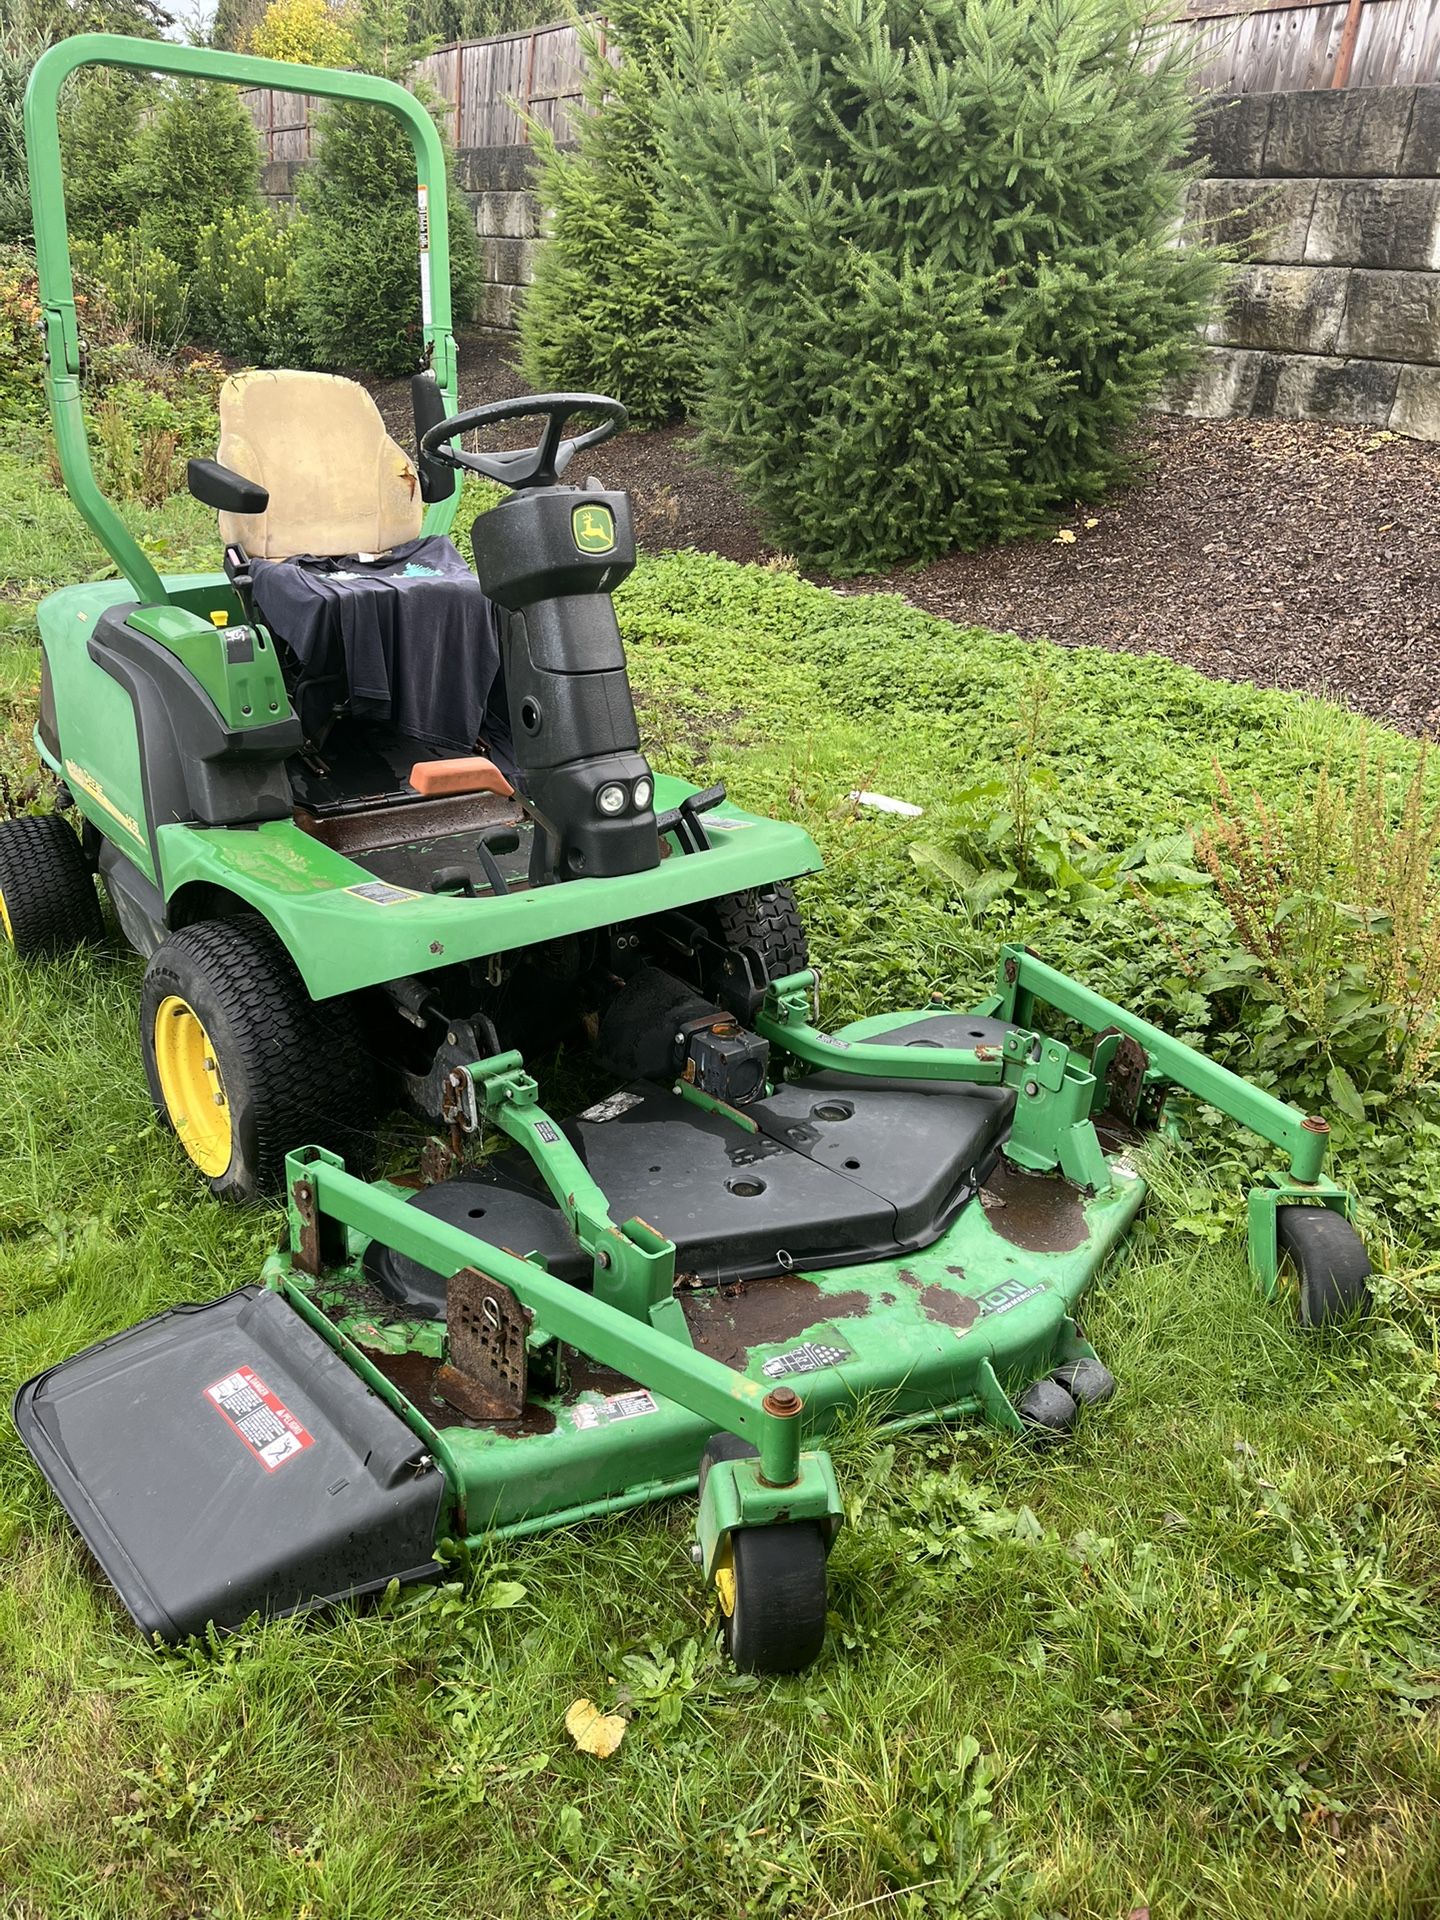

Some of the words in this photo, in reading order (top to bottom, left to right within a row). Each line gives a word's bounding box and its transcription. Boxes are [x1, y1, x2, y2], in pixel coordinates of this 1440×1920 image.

[996, 1286, 1040, 1313] COMMERCIAL
[248, 1376, 270, 1397] DANGER
[281, 1411, 305, 1436] PELIGRO
